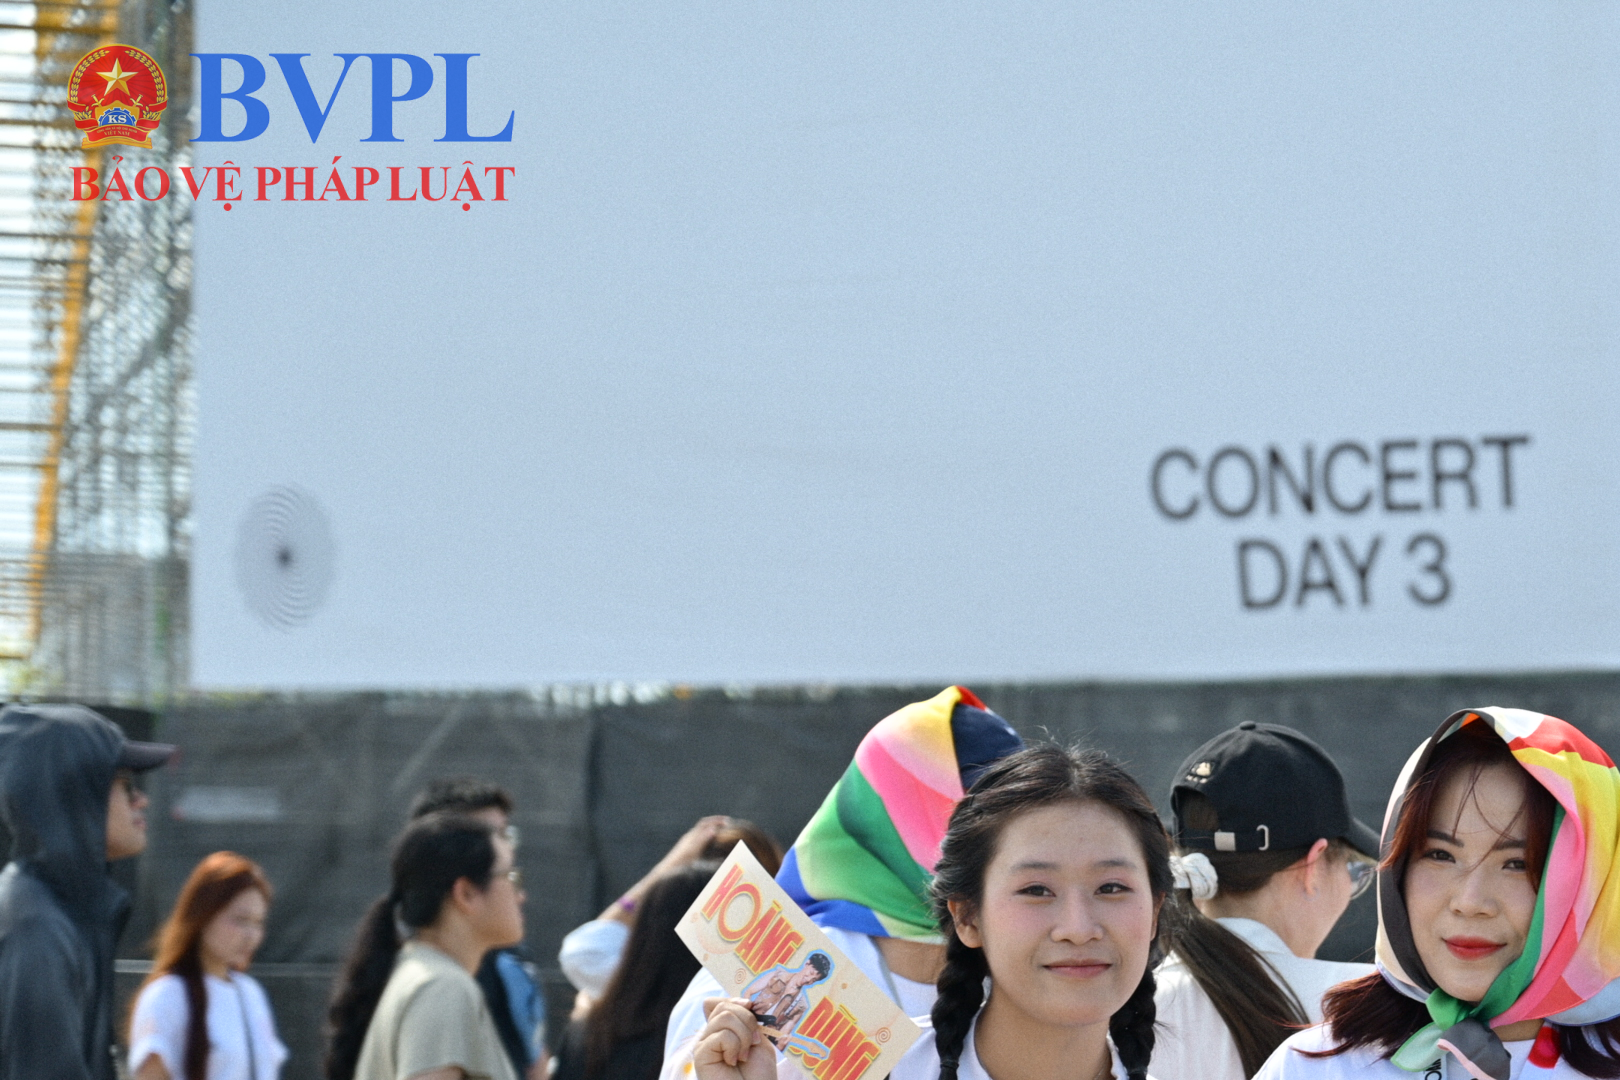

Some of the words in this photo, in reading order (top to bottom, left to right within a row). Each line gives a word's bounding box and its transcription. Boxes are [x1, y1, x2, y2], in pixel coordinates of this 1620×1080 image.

[1149, 432, 1532, 522] CONCERT
[1236, 534, 1385, 611] DAY
[1405, 531, 1455, 609] 3
